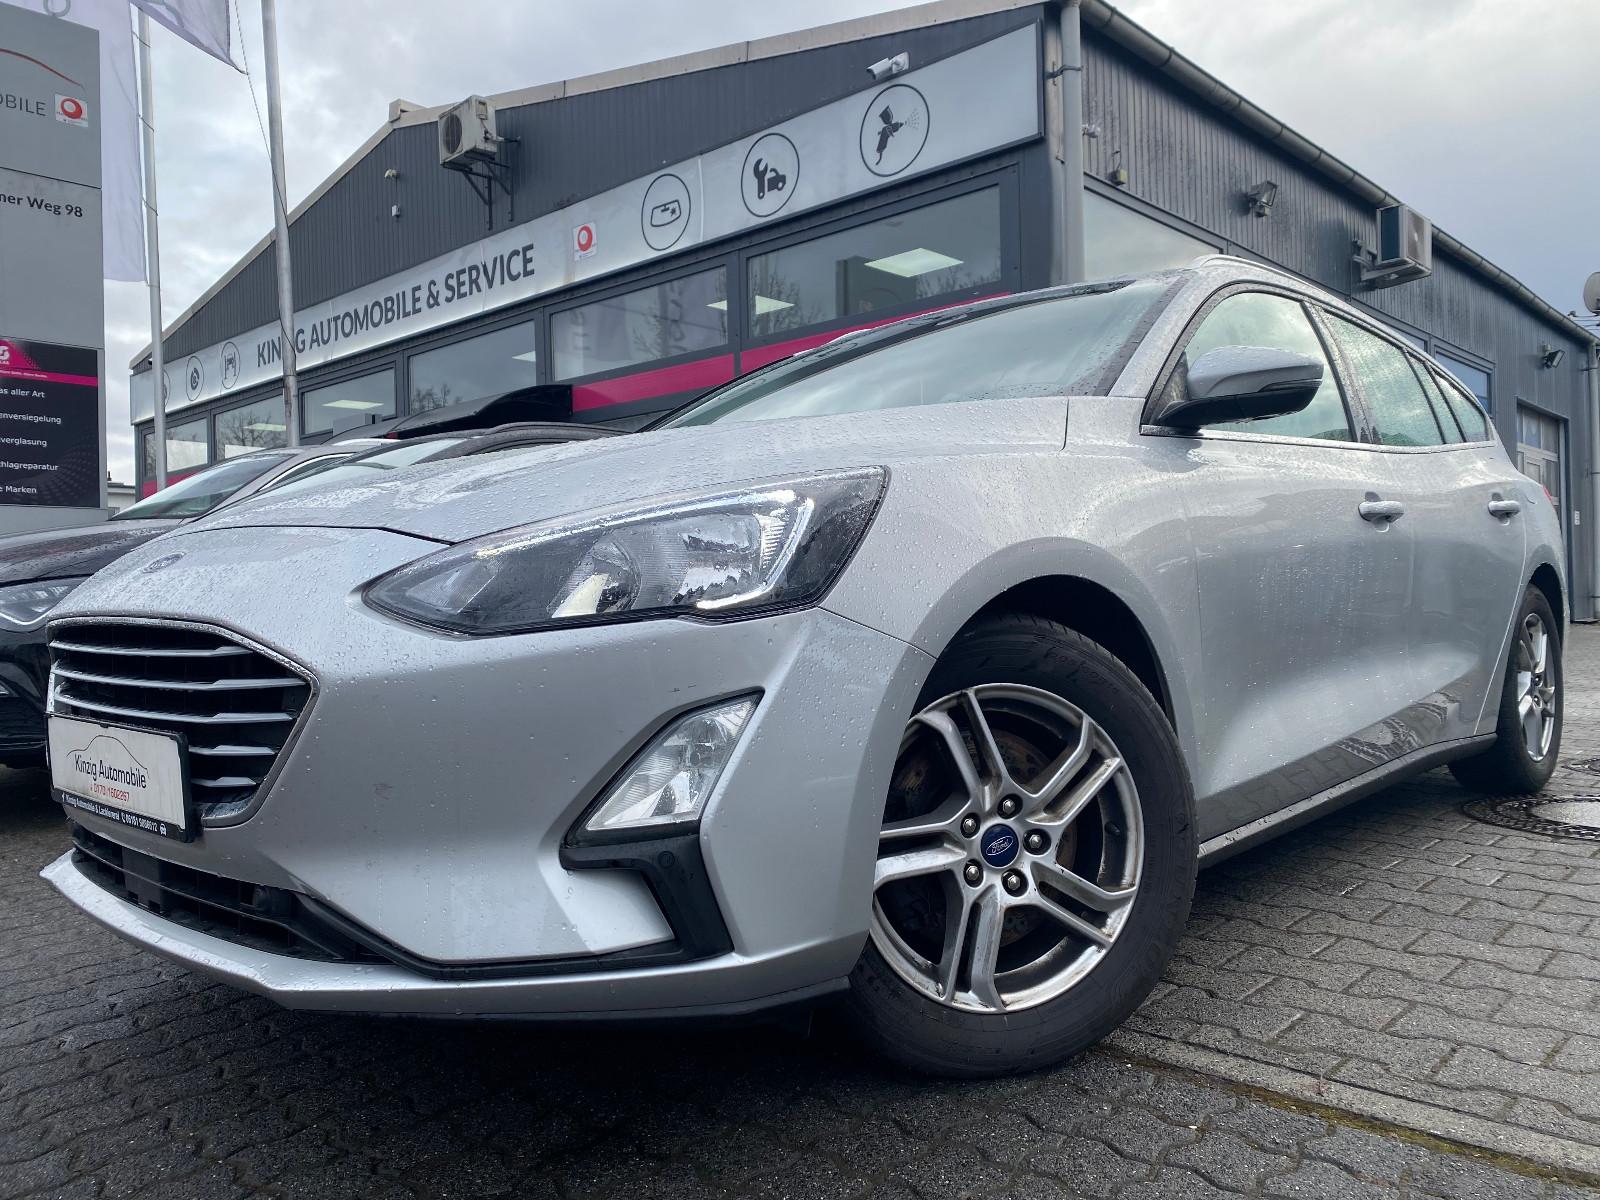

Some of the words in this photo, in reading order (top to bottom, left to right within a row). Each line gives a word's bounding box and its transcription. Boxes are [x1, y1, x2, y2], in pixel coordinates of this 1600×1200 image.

[26, 195, 61, 215] Weg
[65, 204, 83, 218] 98
[256, 327, 306, 368] KING
[309, 284, 423, 351] AUTOMOBILE
[426, 279, 441, 309] &
[444, 243, 535, 303] SERVICE
[10, 388, 30, 396] aller
[31, 390, 46, 398] Art
[5, 485, 37, 493] Marken
[74, 753, 97, 781] Kinzig
[99, 759, 147, 789] Automobile
[991, 838, 1010, 854] Ford
